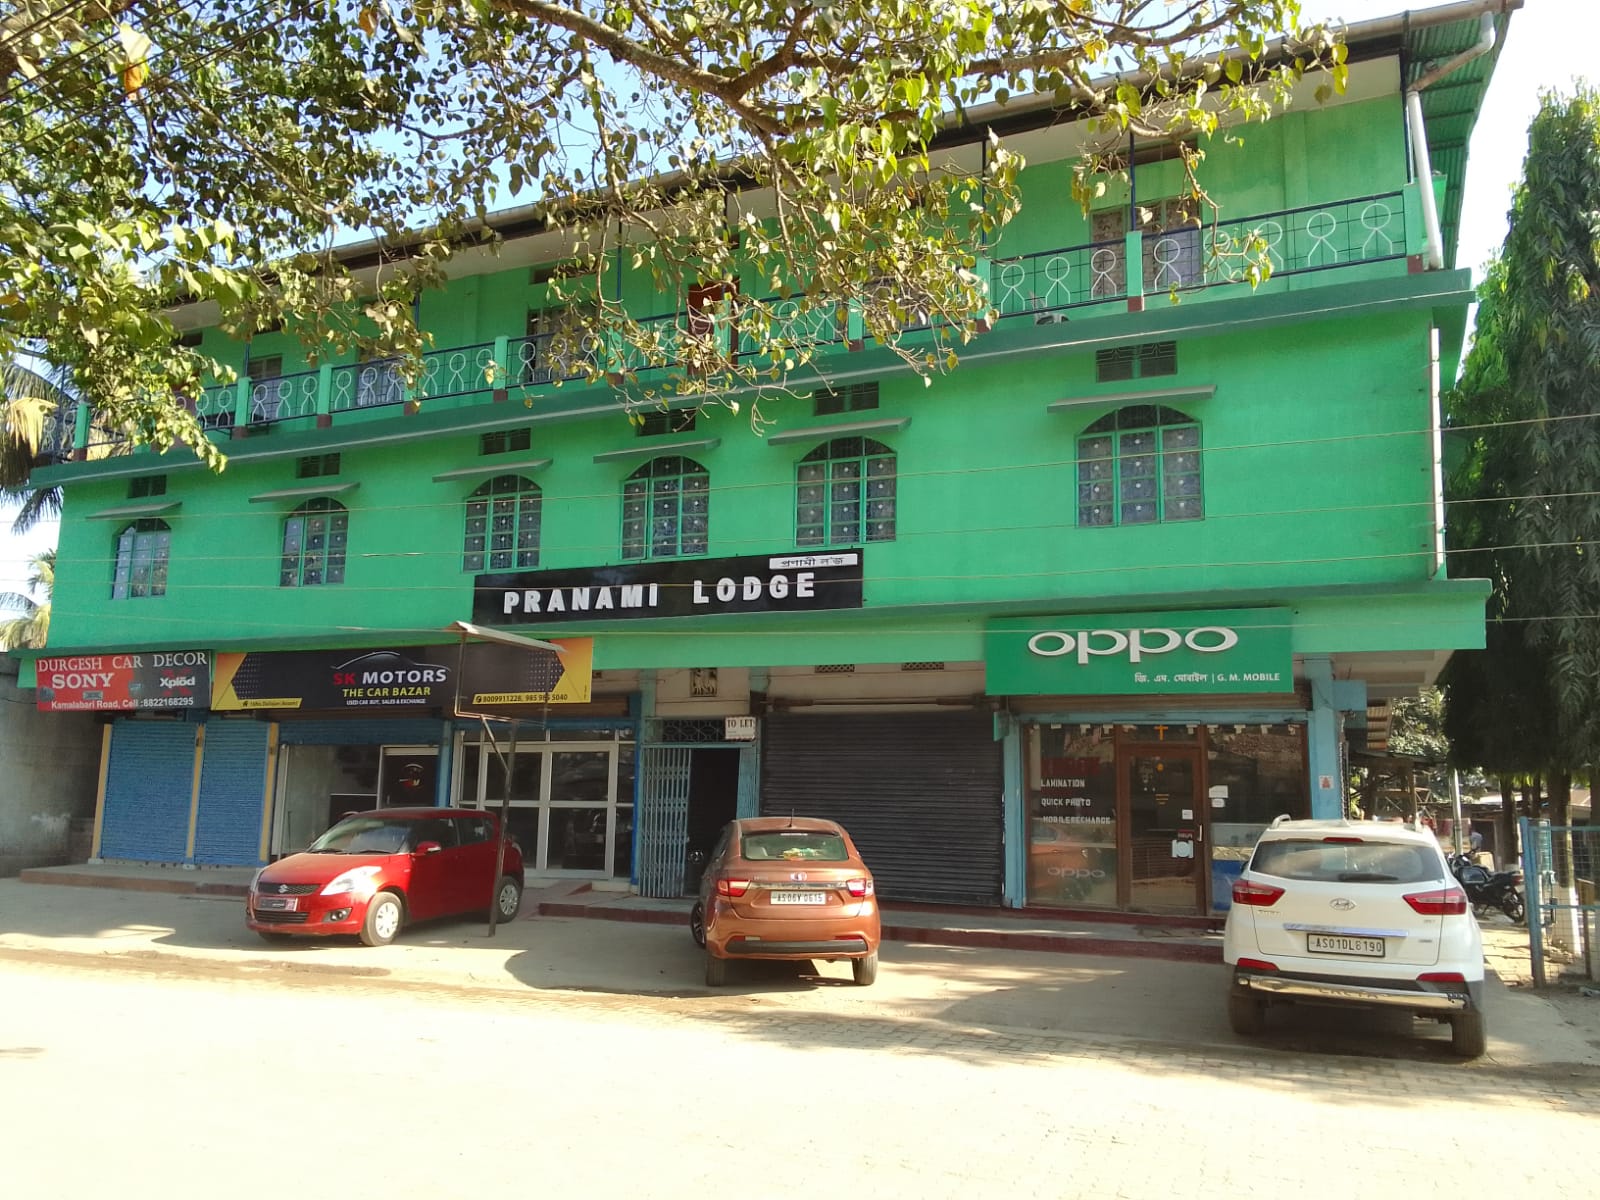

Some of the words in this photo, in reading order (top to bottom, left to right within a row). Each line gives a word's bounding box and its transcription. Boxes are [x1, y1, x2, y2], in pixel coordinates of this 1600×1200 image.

[503, 582, 659, 614] PRANAMI
[693, 572, 815, 604] LODGE
[38, 656, 103, 673] DURGESH
[112, 655, 144, 669] CAR
[153, 652, 208, 668] DECOR
[52, 673, 115, 689] SONY
[333, 672, 356, 686] SK
[362, 669, 447, 684] MOTORS
[1229, 673, 1241, 682] M.
[1243, 672, 1281, 682] MOBILE
[342, 688, 364, 698] THE
[367, 687, 389, 697] CAR
[392, 686, 431, 697] BAZAR
[51, 701, 95, 709] Kamalabari
[728, 719, 737, 728] TO
[740, 719, 753, 728] LET
[1041, 798, 1064, 807] QUICK
[1065, 798, 1092, 807] PHOTO
